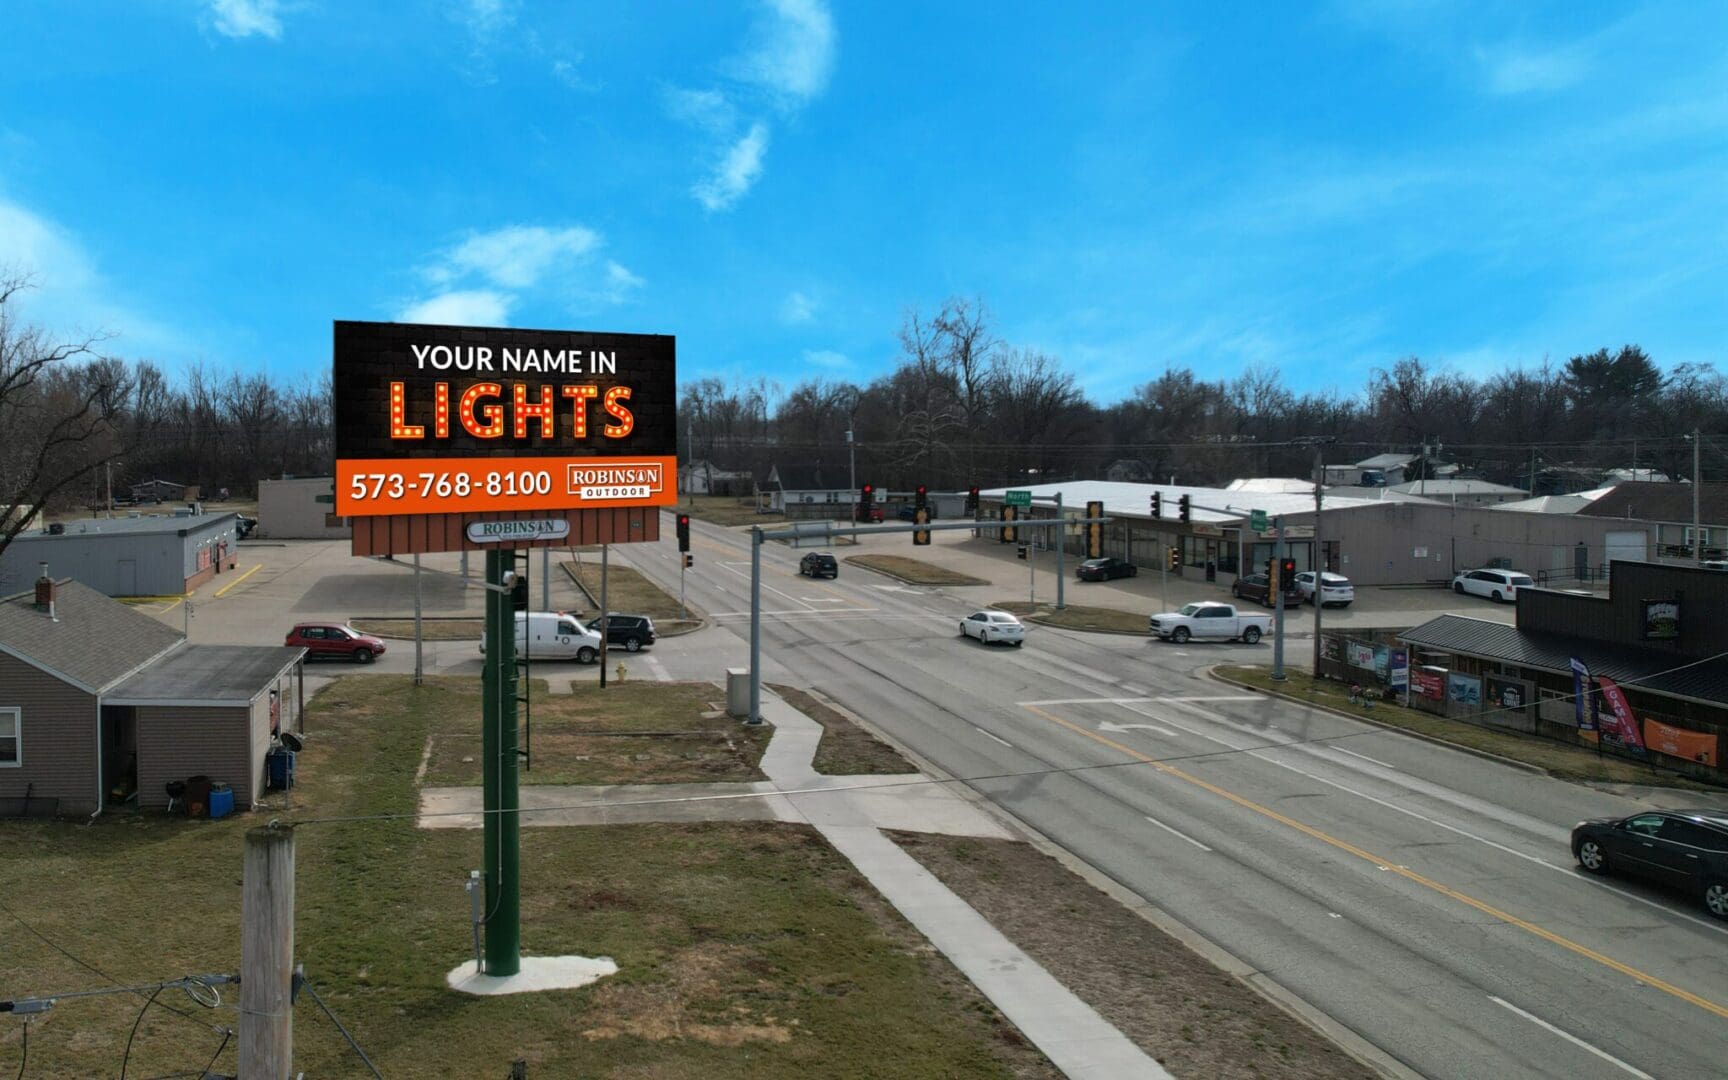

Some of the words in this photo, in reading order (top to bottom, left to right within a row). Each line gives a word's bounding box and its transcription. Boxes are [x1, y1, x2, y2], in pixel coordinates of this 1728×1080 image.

[411, 344, 494, 371] YOUR
[502, 348, 583, 374] NAME
[590, 350, 616, 375] IN
[389, 381, 634, 439] LIGHTS
[350, 471, 551, 500] 573-768-8100
[573, 469, 658, 485] ROBINSON
[586, 487, 645, 497] OUTDOOR
[483, 519, 555, 535] ROBINSON
